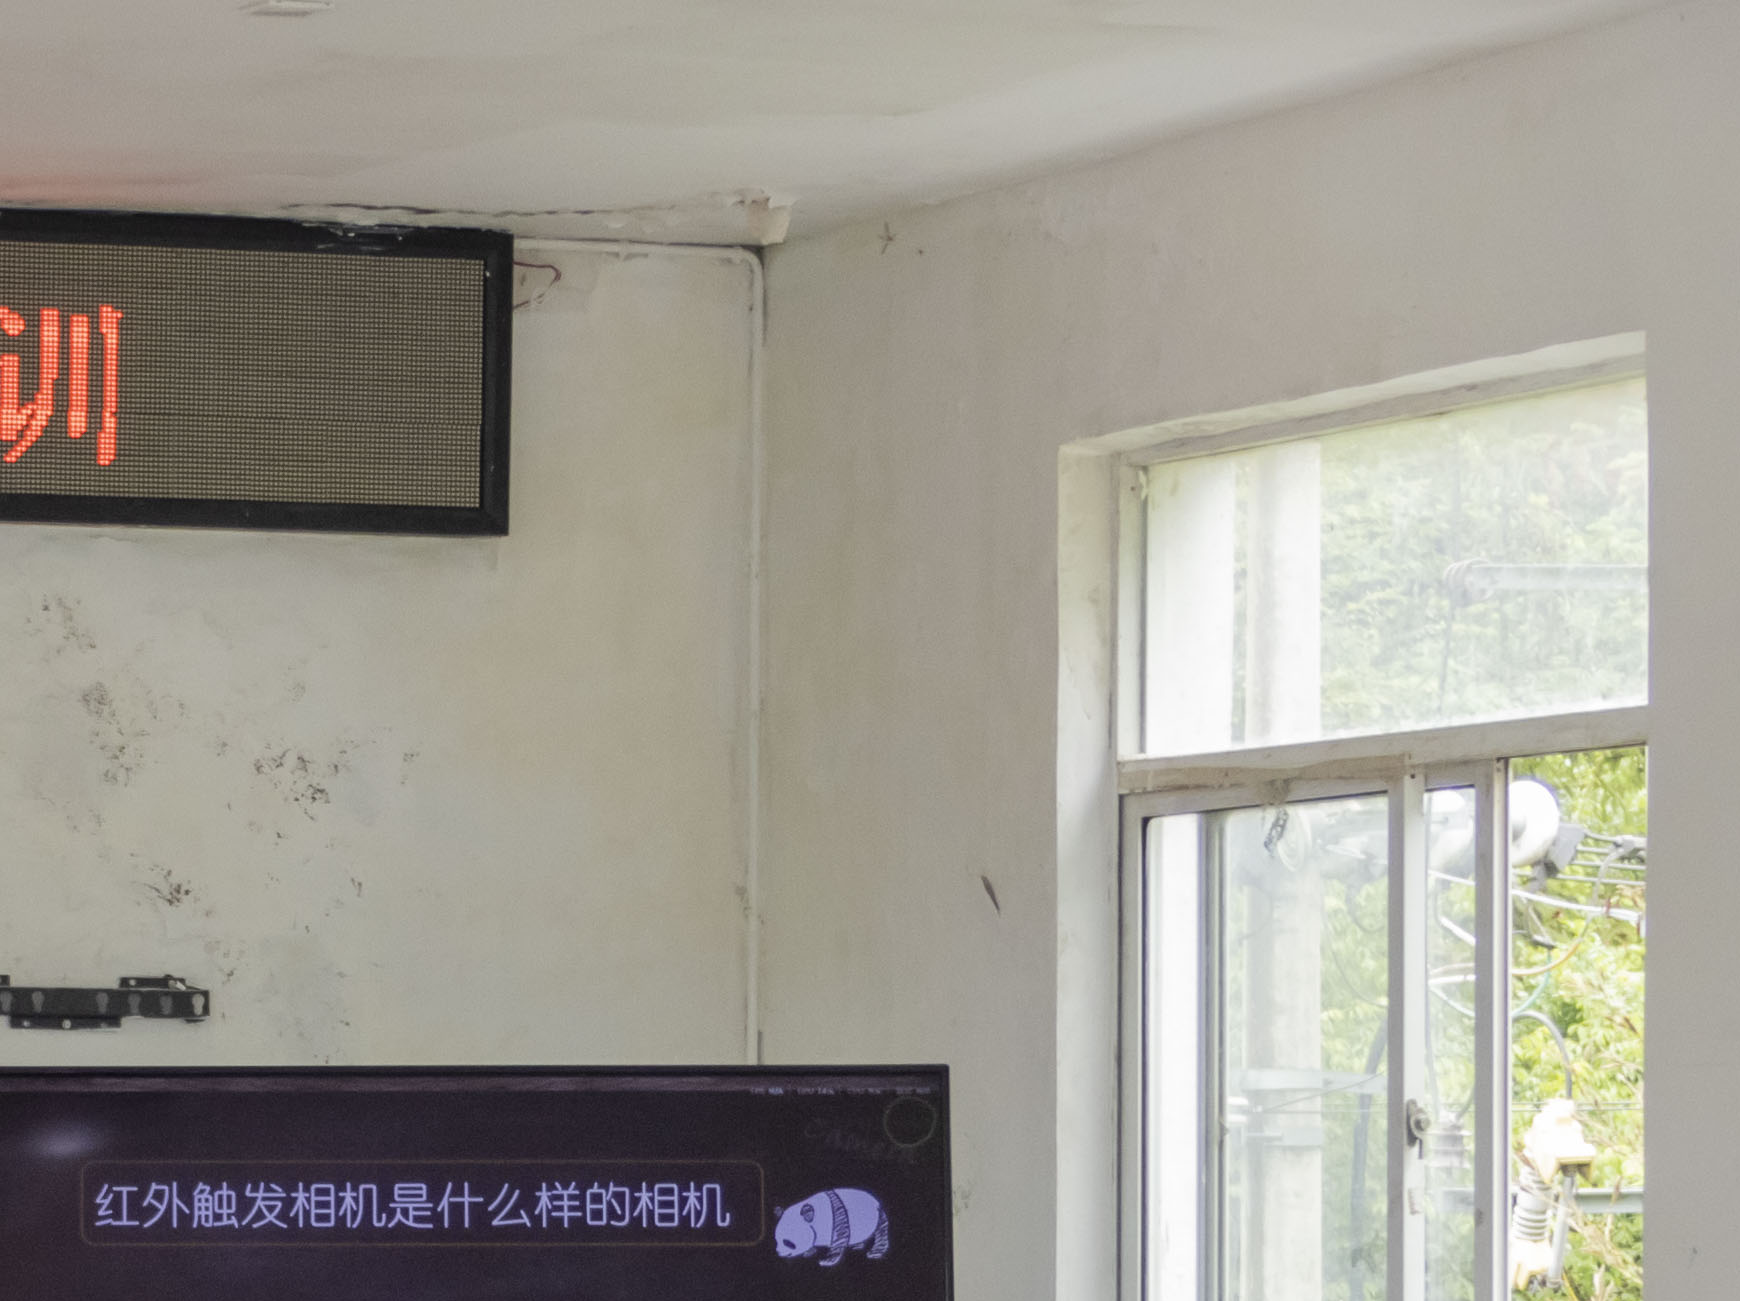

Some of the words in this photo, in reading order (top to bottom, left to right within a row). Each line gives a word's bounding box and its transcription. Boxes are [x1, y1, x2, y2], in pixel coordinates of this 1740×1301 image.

[94, 1181, 732, 1230] 红外触发相机是什么样的相机
